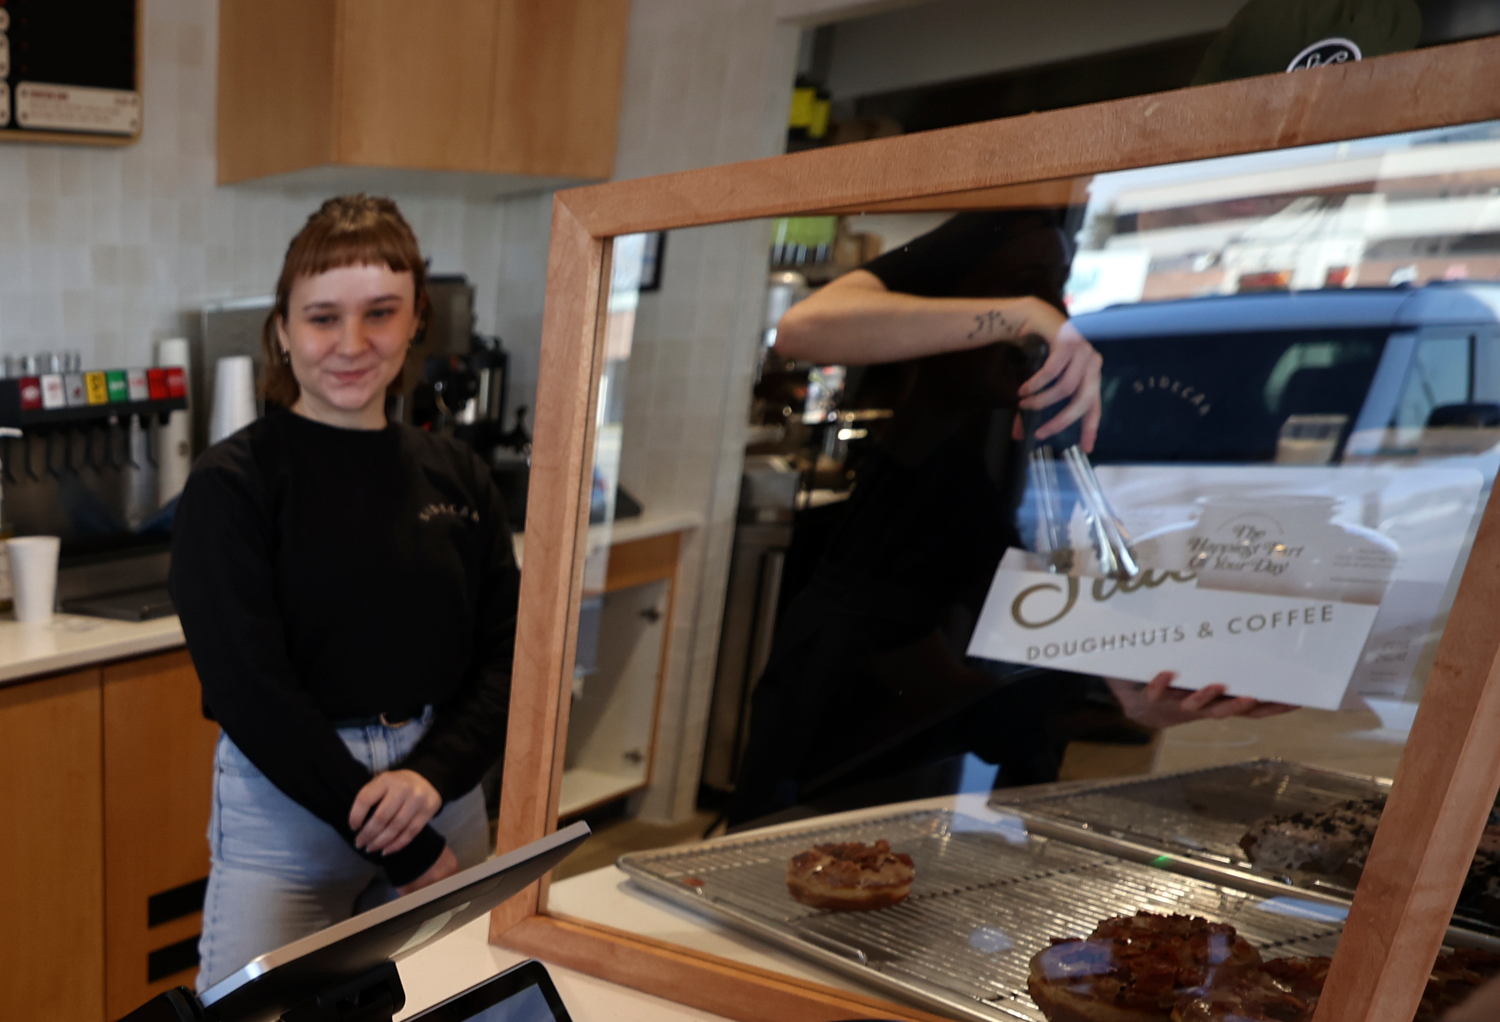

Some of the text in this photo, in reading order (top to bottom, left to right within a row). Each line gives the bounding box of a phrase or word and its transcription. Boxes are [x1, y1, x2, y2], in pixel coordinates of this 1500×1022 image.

[1026, 604, 1334, 661] DOUGHNUTS & COFFEE
